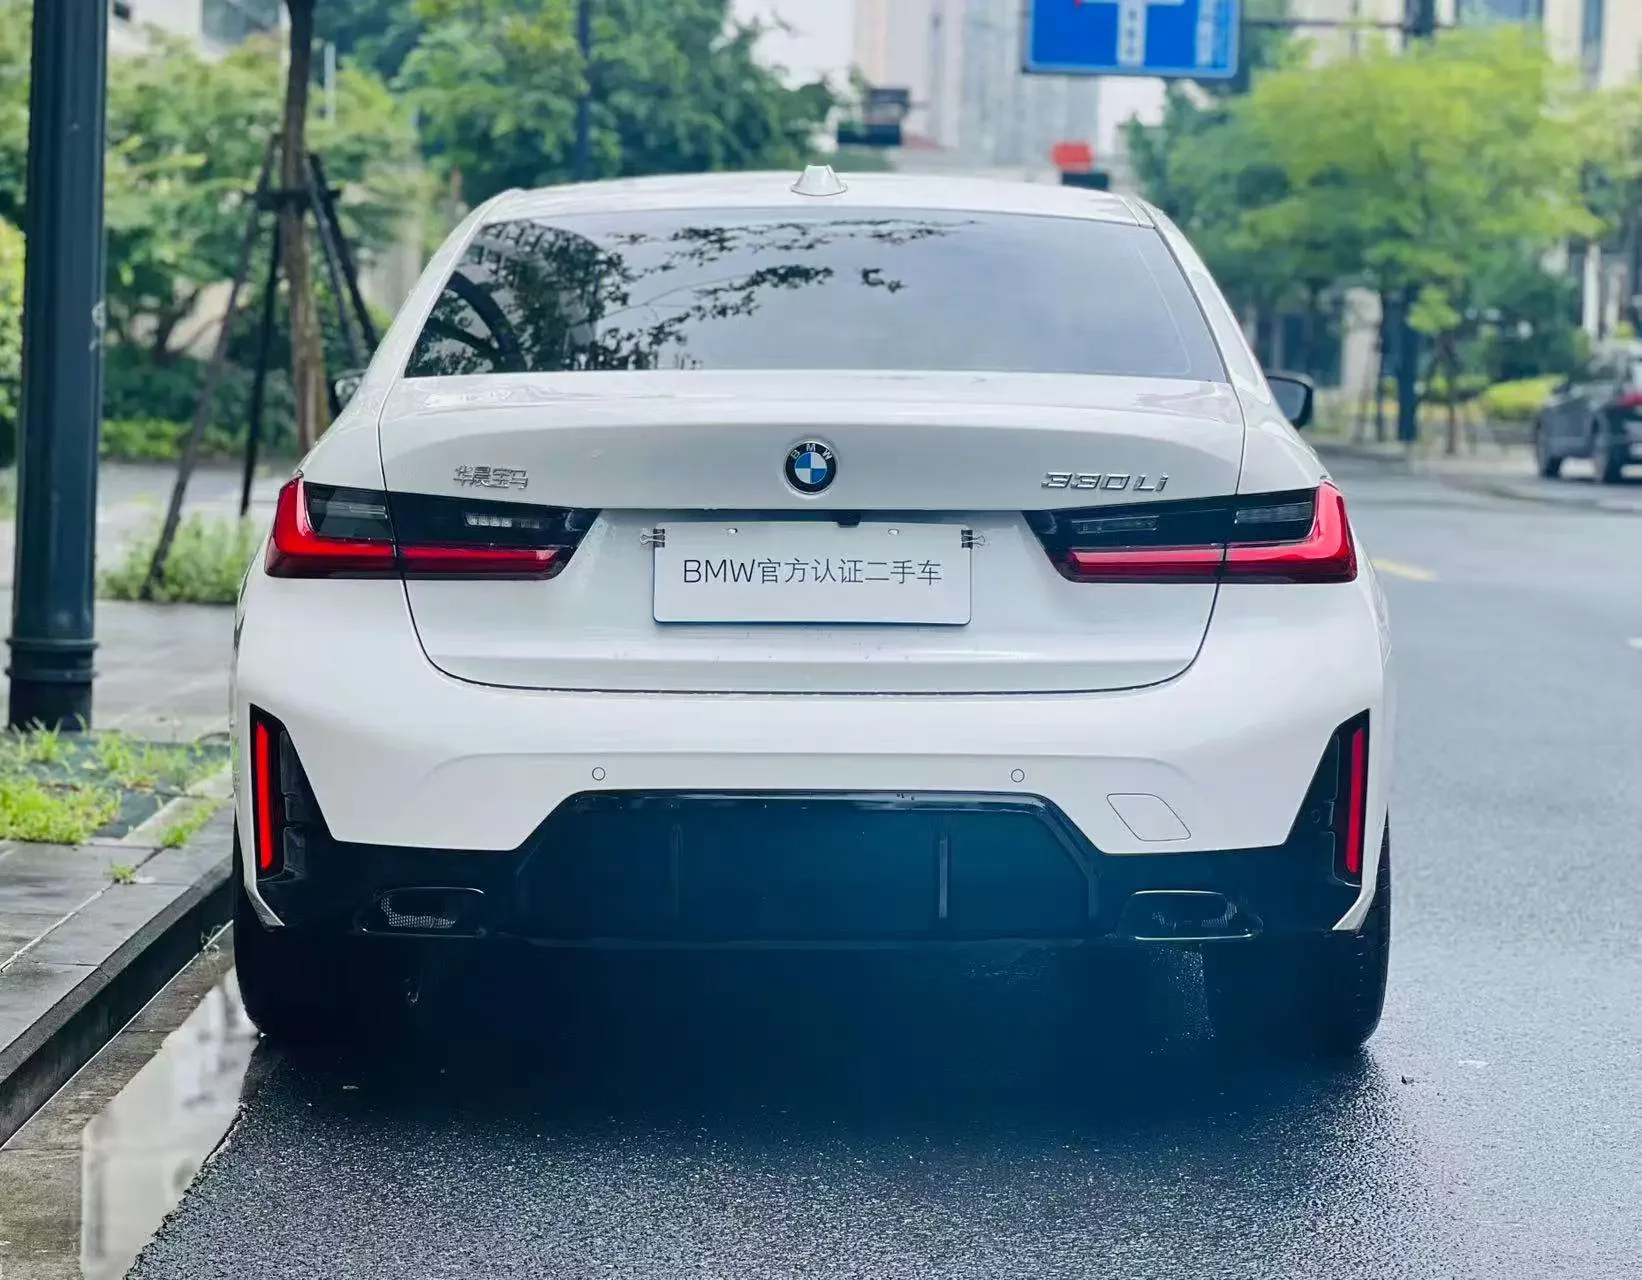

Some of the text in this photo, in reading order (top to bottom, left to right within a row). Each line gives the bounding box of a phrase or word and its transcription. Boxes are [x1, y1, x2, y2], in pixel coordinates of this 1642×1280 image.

[790, 443, 833, 460] BMW
[453, 465, 528, 489] 华晨宝马
[682, 557, 942, 585] BMW官方认证二手车
